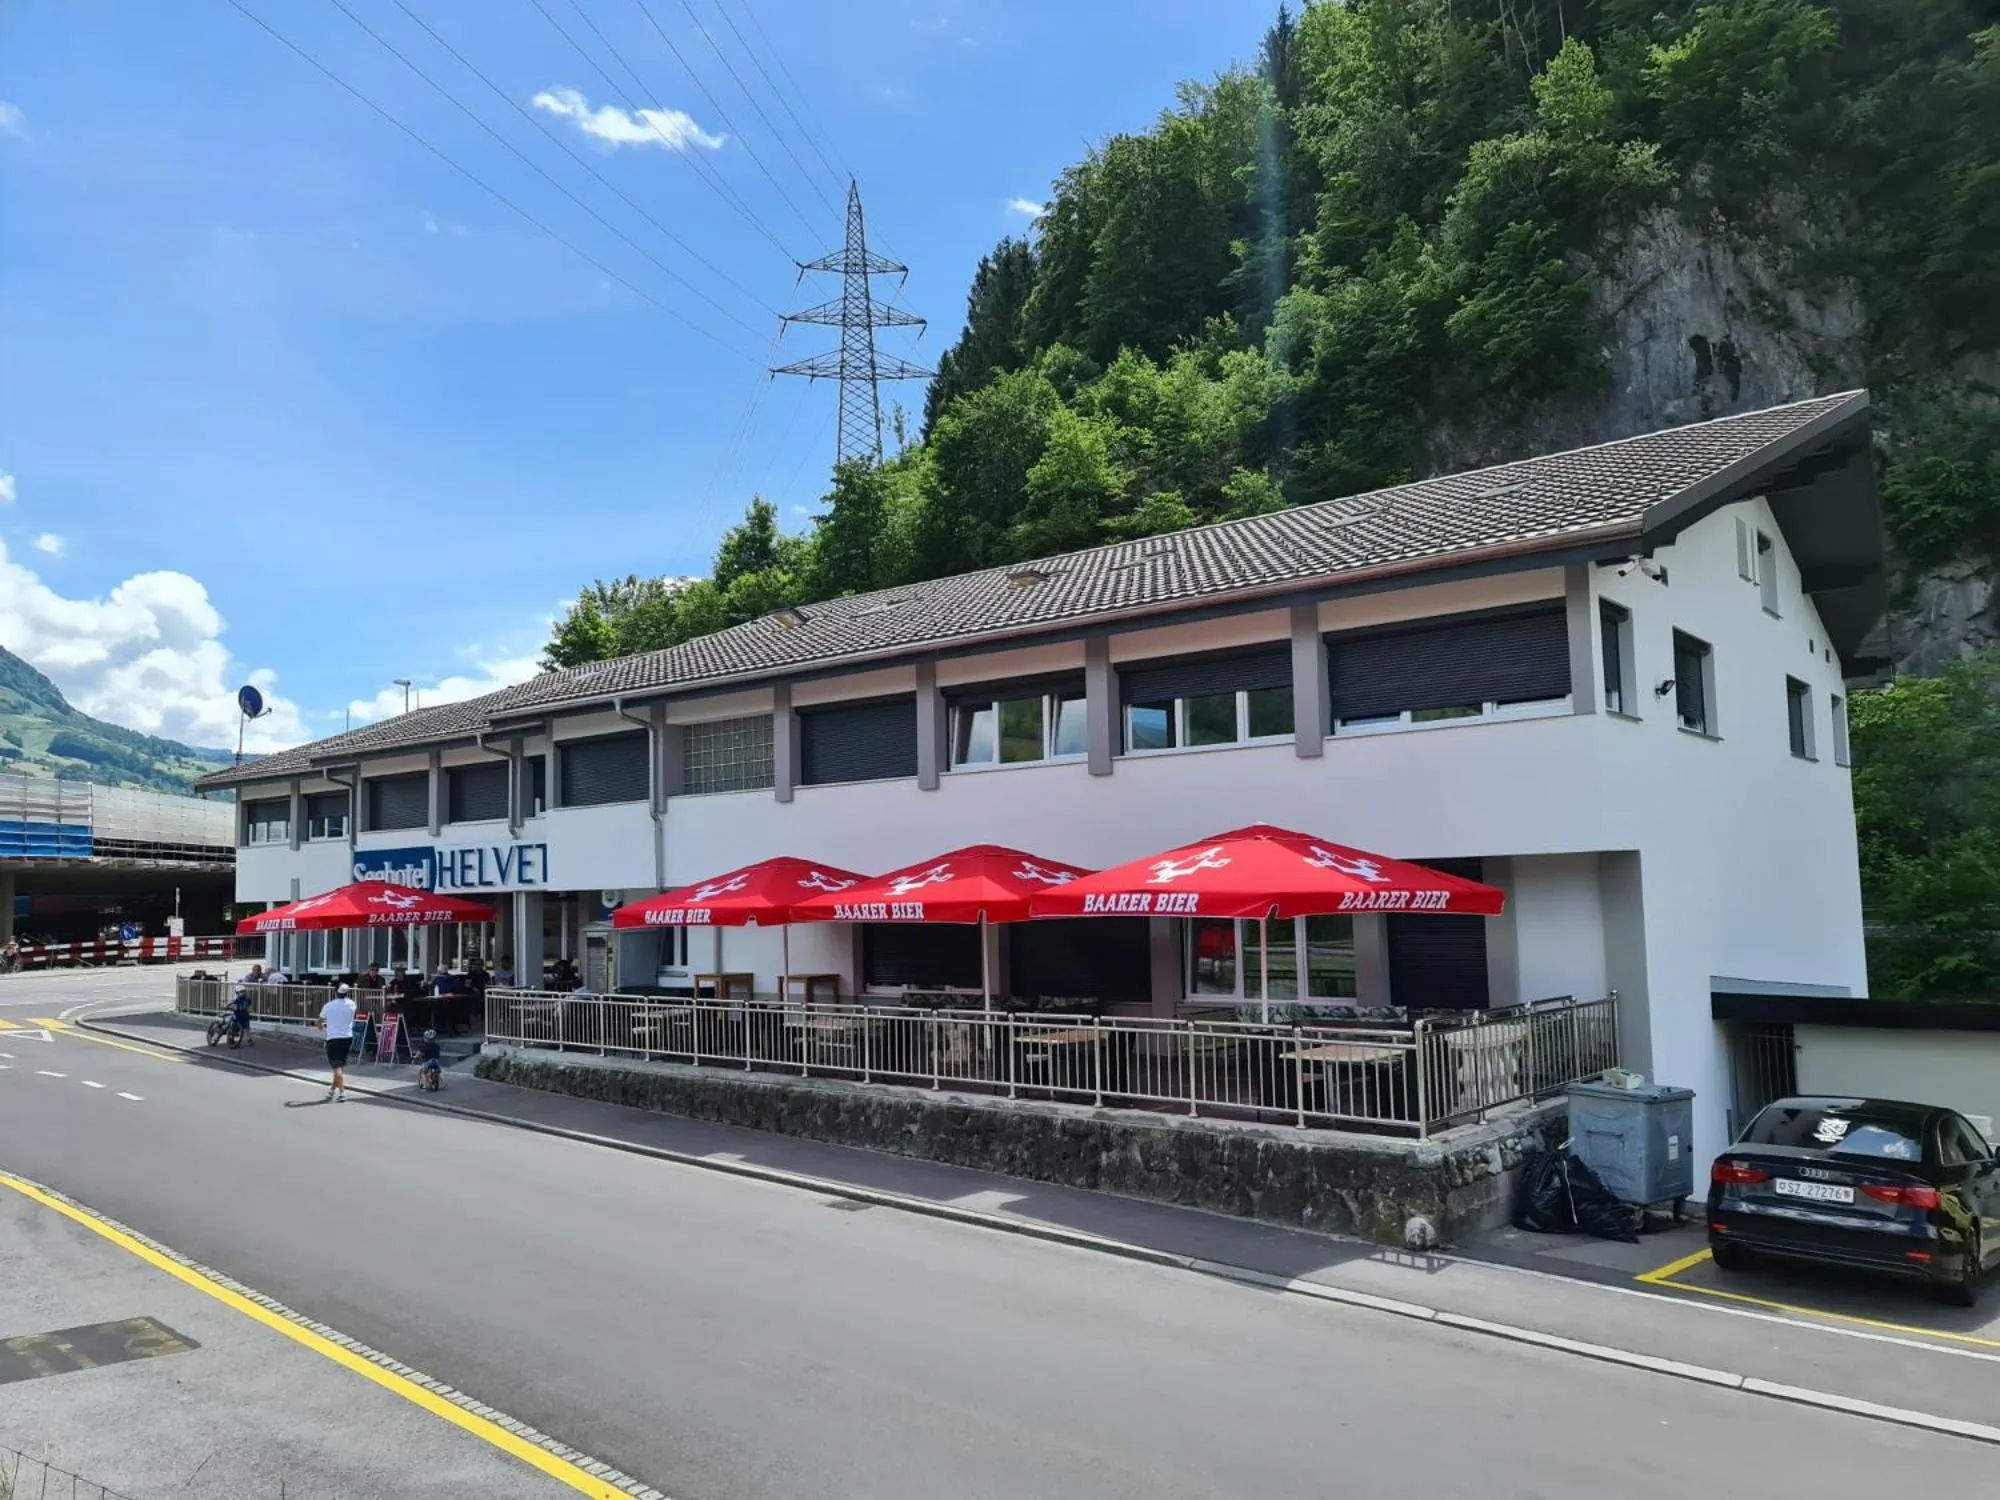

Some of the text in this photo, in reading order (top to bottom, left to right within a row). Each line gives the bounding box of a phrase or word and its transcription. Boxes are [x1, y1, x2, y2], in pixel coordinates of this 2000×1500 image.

[1083, 893, 1199, 912] BAARER BIER
[1338, 890, 1450, 909] BAARER BIER
[368, 910, 453, 923] BAARER BIER
[645, 908, 711, 924] BAARER BIER
[833, 902, 924, 919] BAARER BIER
